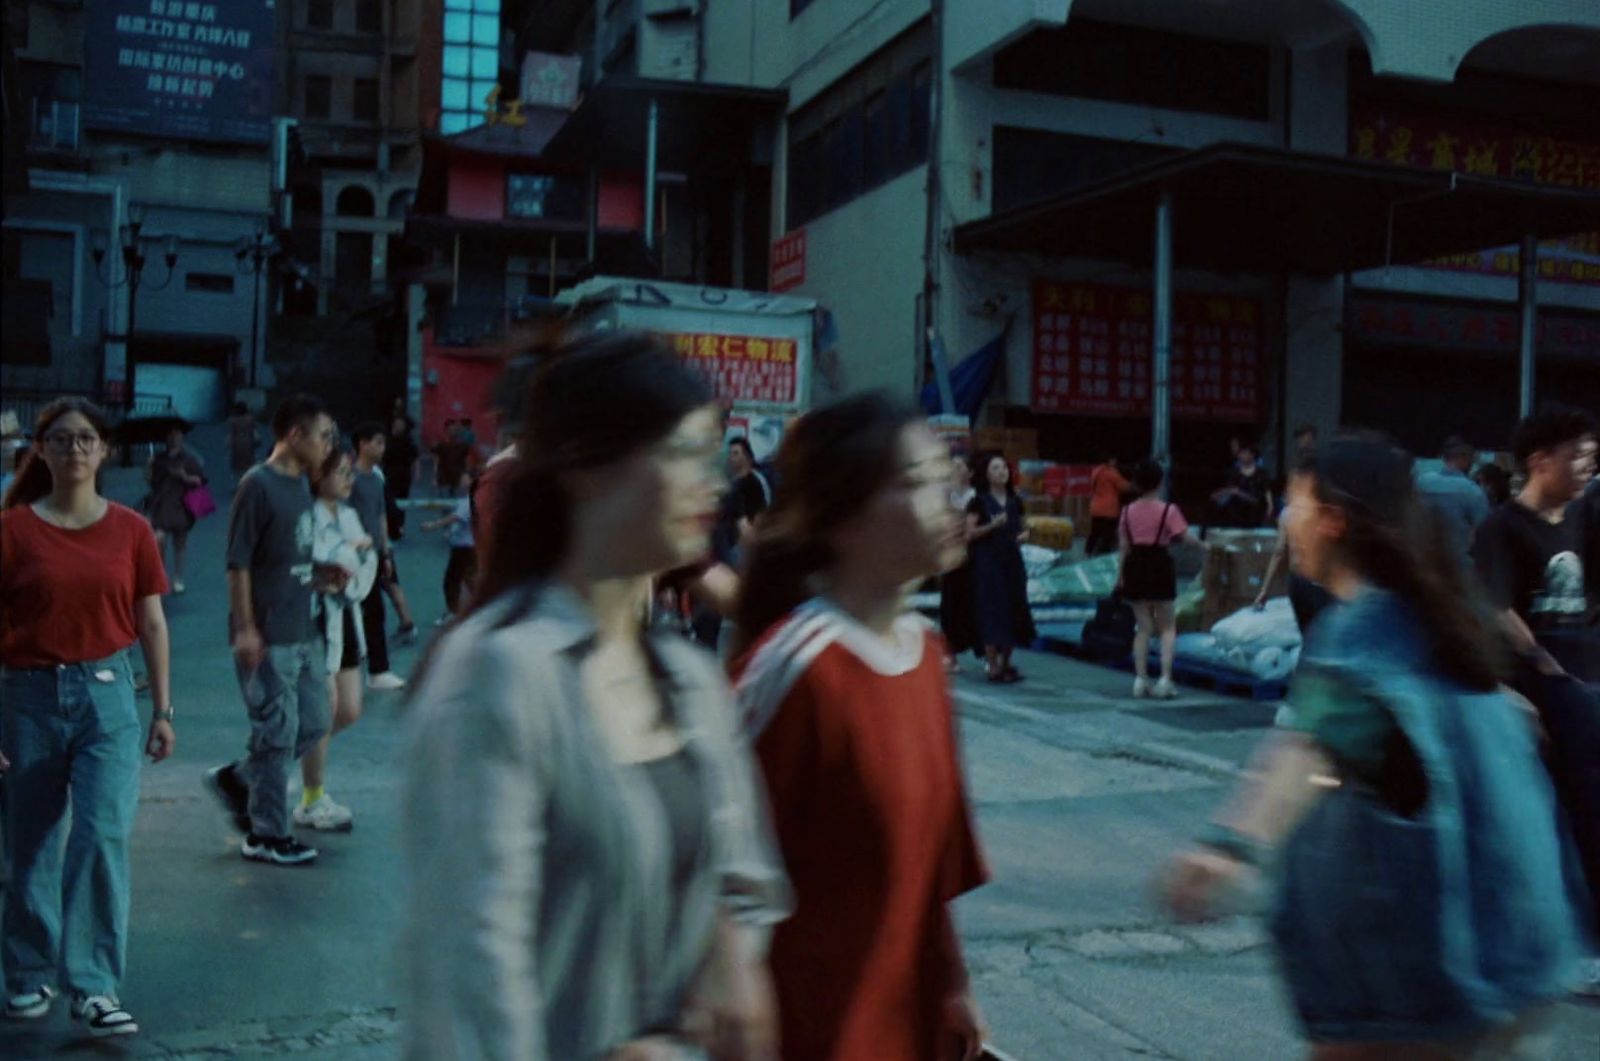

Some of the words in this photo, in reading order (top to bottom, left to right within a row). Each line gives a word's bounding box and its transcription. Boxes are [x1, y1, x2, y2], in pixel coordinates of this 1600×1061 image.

[671, 333, 794, 364] 利宏仁物流
